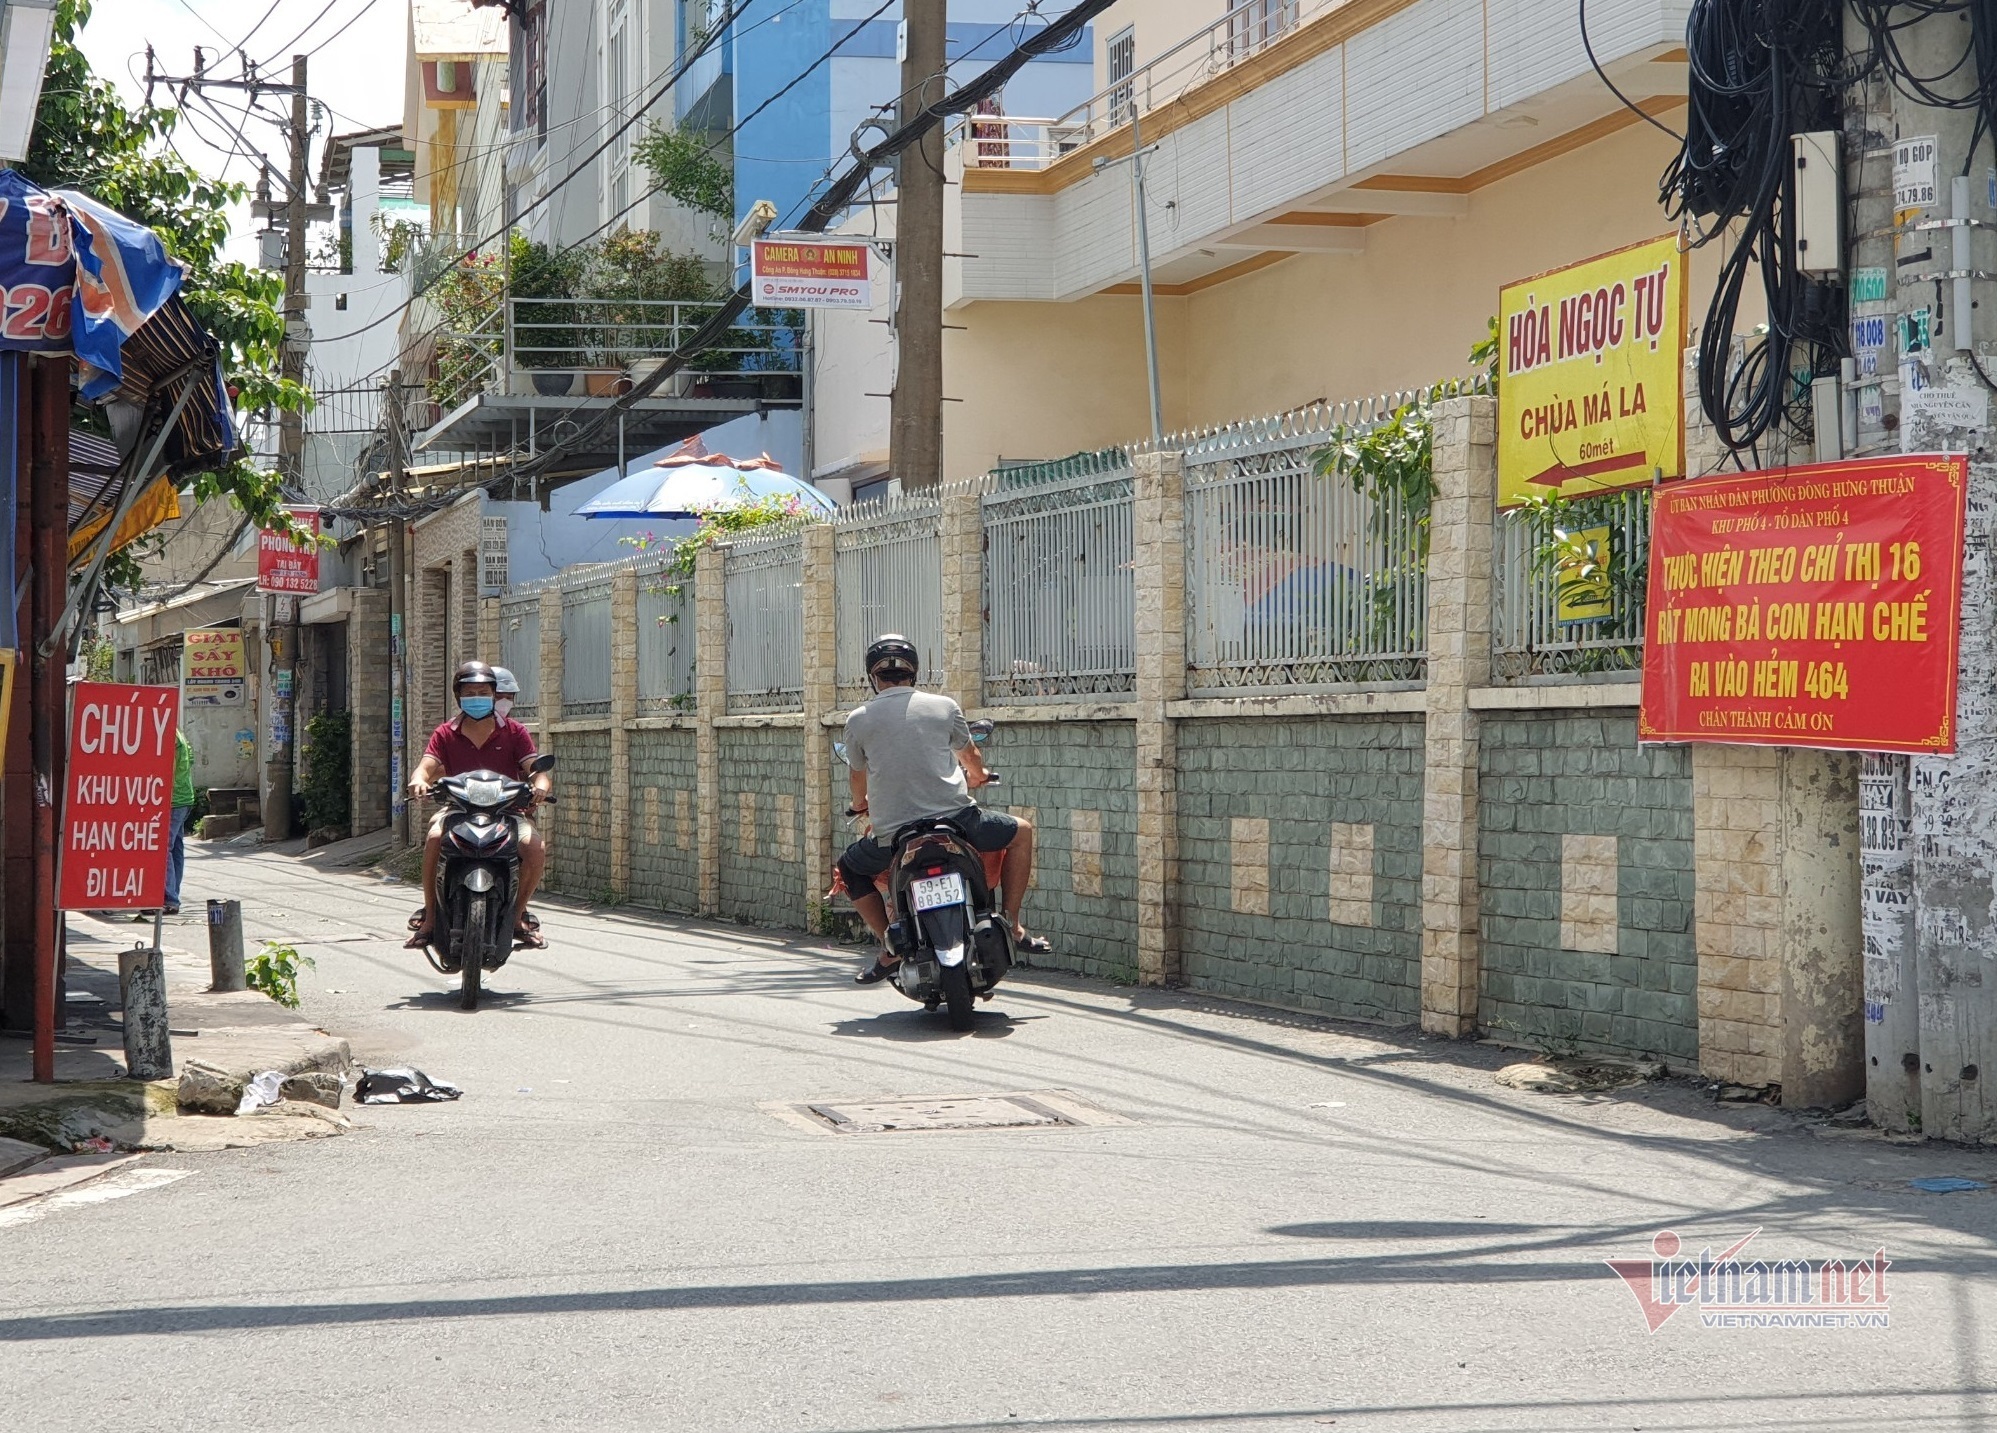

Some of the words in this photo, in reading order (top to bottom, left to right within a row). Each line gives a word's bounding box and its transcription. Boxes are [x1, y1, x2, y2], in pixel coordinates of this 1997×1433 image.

[1912, 142, 1933, 163] GÓP
[764, 246, 799, 262] CAMERA
[823, 249, 836, 263] AN
[837, 250, 858, 265] NINH
[778, 286, 828, 295] SMYOU
[830, 287, 859, 296] PRO
[1508, 294, 1551, 375] HÒA
[1558, 282, 1625, 365] NGỌC
[1634, 262, 1669, 351] TỰ
[1520, 394, 1577, 440] CHÙA
[1583, 381, 1611, 427] MÁ
[1620, 382, 1647, 418] LA
[1579, 437, 1614, 460] 60mét
[1680, 496, 1698, 513] BAN
[1699, 490, 1726, 510] NHÂN
[1729, 487, 1749, 506] DÂN
[1752, 482, 1796, 504] PHƯỜNG
[1798, 480, 1830, 501] ĐÔNG
[1832, 480, 1867, 498] HƯNG
[1870, 472, 1915, 497] THUẬN
[1711, 519, 1735, 535] KHU
[1736, 510, 1760, 532] PHỐ
[1760, 516, 1767, 531] 4
[1774, 506, 1789, 529] TỔ
[1791, 508, 1814, 528] DÂN
[1816, 504, 1840, 527] PHỐ
[1842, 510, 1849, 525] 4
[1663, 551, 1698, 597] THỰC
[1701, 543, 1744, 594] HIỆN
[1747, 546, 1797, 585] THEO
[1800, 532, 1843, 582] CHỈ
[1845, 542, 1880, 590] THỊ
[1889, 541, 1921, 581] 16
[286, 577, 299, 589] 132
[300, 578, 318, 590] 5228
[1657, 596, 1682, 645] RẤT
[1683, 605, 1732, 643] MONG
[1735, 596, 1760, 641] BÀ
[1765, 602, 1810, 640] CON
[1815, 602, 1865, 649] HẠN
[1872, 589, 1932, 642] CHẾ
[192, 647, 237, 661] SẤY
[190, 664, 238, 677] KHÔ
[1689, 661, 1710, 698] RA
[1715, 653, 1749, 698] VÀO
[1752, 648, 1799, 698] HẺM
[1804, 661, 1849, 700] 464
[80, 692, 143, 755] CHÚ
[152, 693, 172, 756] Ý
[1699, 706, 1728, 727] CHÂN
[1730, 706, 1771, 728] THÀNH
[1774, 706, 1807, 730] CẢM
[1810, 711, 1834, 731] ƠN
[76, 775, 120, 805] KHU
[125, 774, 164, 812] VỰC
[72, 821, 116, 858] HẠN
[121, 811, 163, 851] CHẾ
[87, 868, 107, 897] ĐI
[112, 868, 144, 904] LẠI
[918, 889, 961, 908] 883.52
[919, 876, 953, 894] 59-E1
